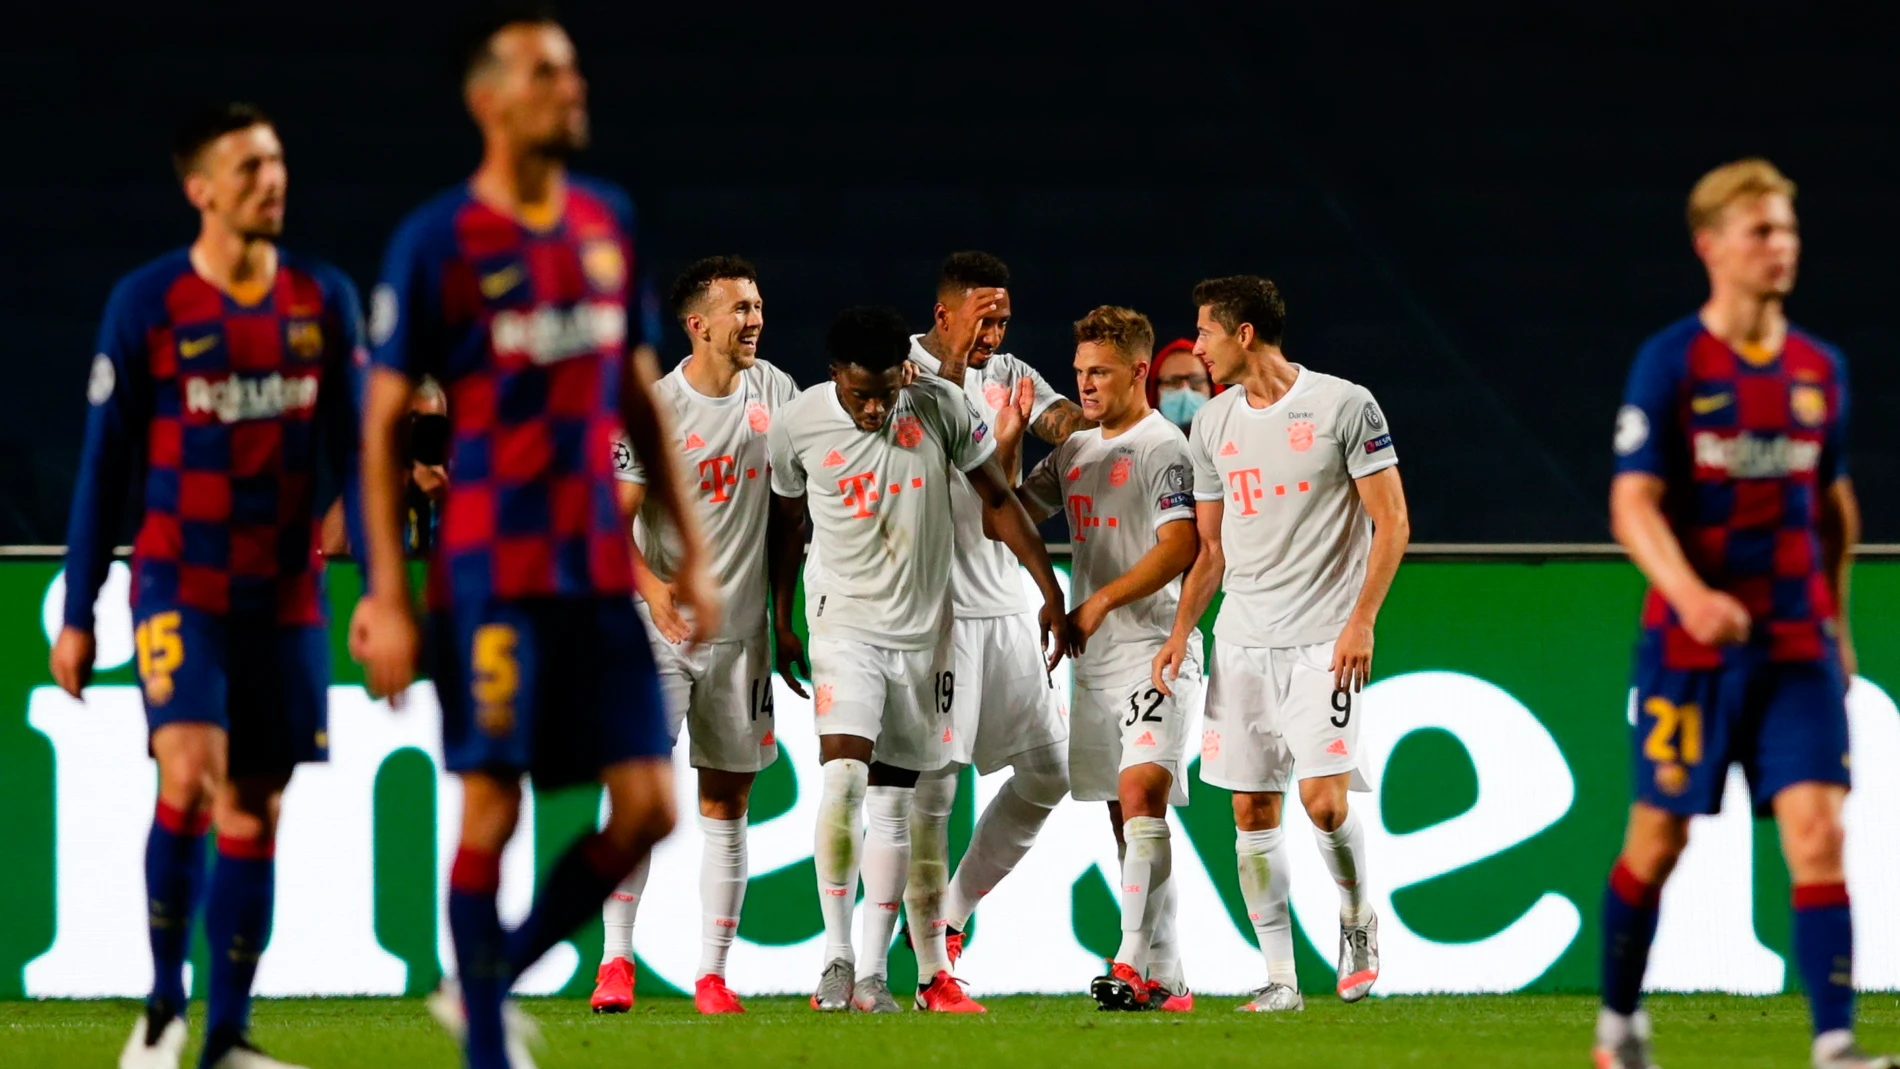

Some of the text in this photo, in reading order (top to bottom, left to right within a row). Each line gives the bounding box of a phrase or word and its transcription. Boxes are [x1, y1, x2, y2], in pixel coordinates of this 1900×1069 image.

[1288, 411, 1314, 420] Danke
[135, 611, 185, 681] 15
[470, 622, 519, 704] 5
[752, 676, 774, 721] 14
[935, 671, 954, 713] 19
[1126, 687, 1165, 726] 32
[1330, 688, 1352, 728] 9
[1642, 695, 1704, 766] 21
